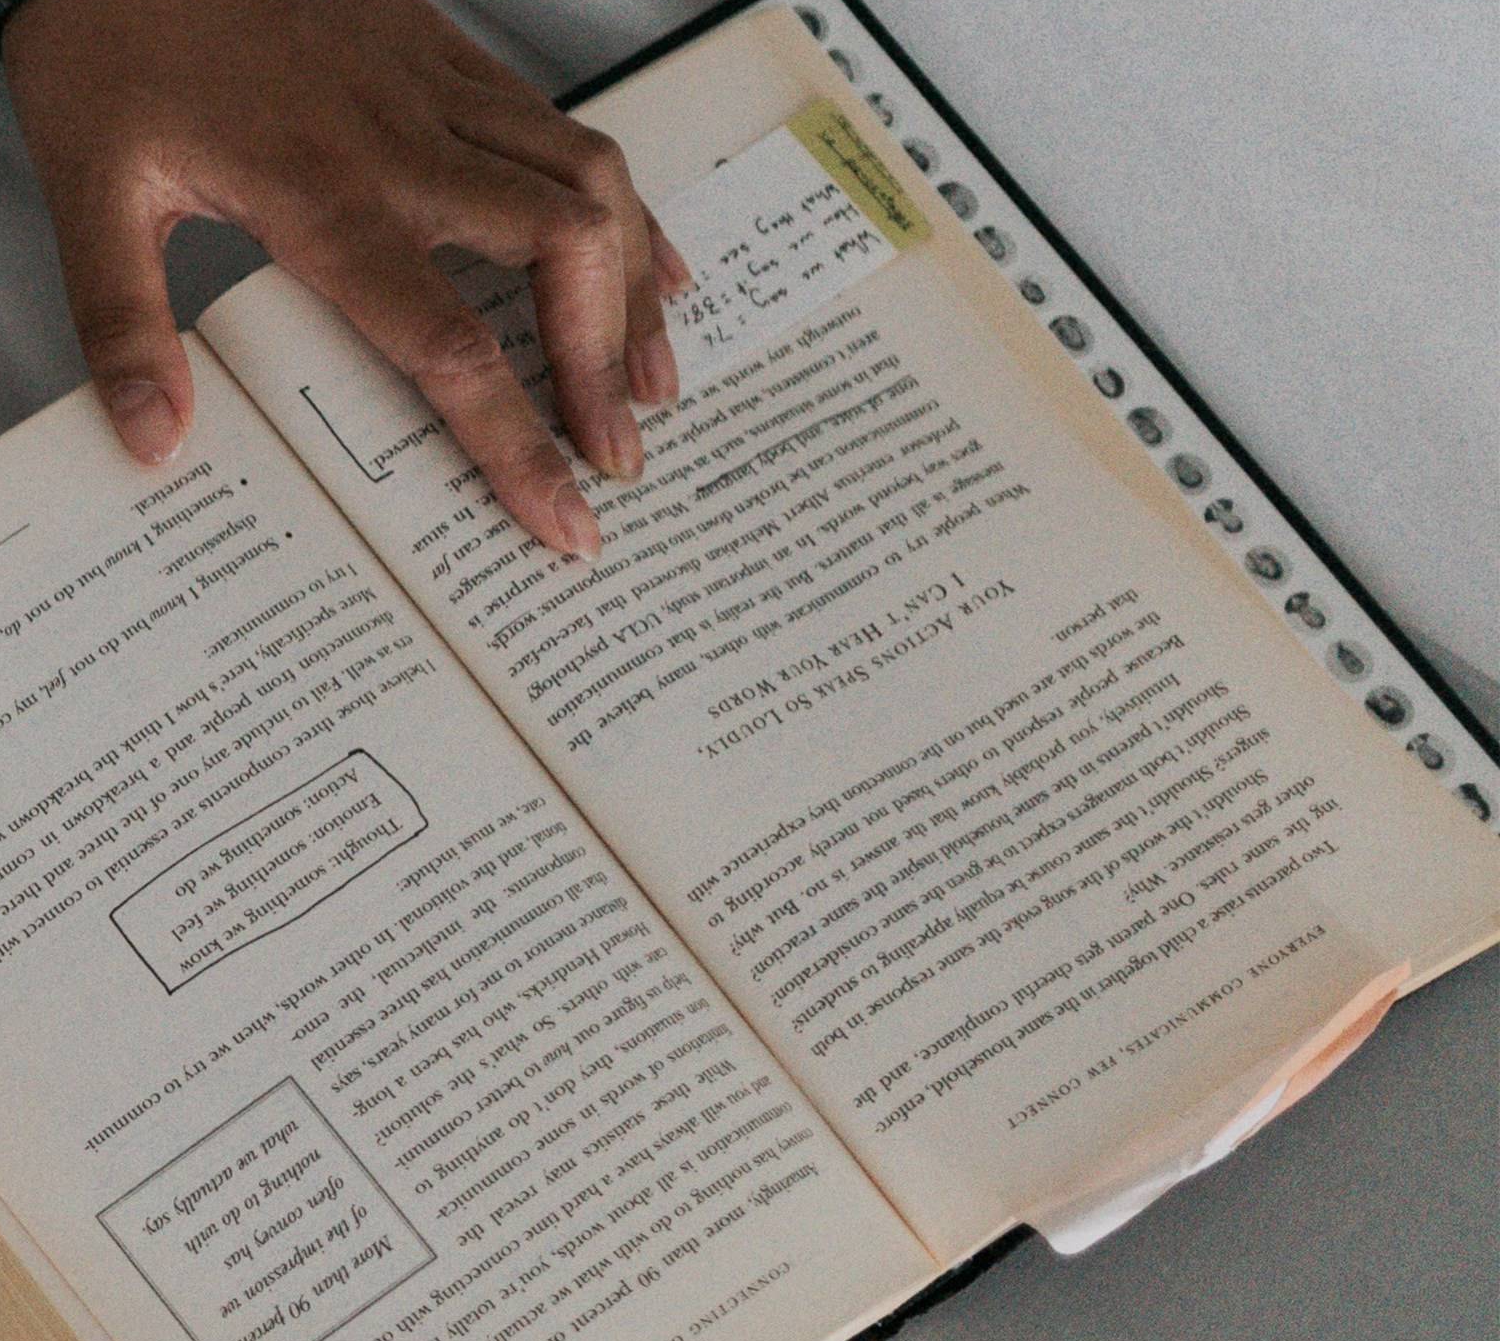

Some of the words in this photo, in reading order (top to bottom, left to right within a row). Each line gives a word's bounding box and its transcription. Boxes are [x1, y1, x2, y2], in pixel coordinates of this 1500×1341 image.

[126, 457, 216, 522] theoretical.
[152, 508, 262, 585] dispassionate.
[947, 568, 966, 591] I
[299, 765, 363, 815] Action:
[215, 801, 308, 869] something
[304, 789, 384, 849] Emotion:
[322, 811, 406, 874] Thought:
[170, 874, 202, 903] do
[194, 858, 226, 886] we
[218, 835, 315, 906] something
[198, 893, 229, 921] we
[239, 860, 334, 930] something
[167, 909, 207, 943] feel
[217, 917, 248, 945] we
[172, 934, 226, 978] know
[1240, 920, 1331, 983] EVERYONE
[1112, 972, 1249, 1061] COMMUNICATES,
[690, 1052, 737, 1091] While
[1081, 1050, 1120, 1083] FEW
[648, 1079, 696, 1119] these
[1000, 1073, 1086, 1133] CONNECT
[256, 1118, 303, 1158] what
[577, 1108, 652, 1165] statistics
[232, 1147, 262, 1175] we
[255, 1144, 327, 1202] nothing
[537, 1153, 582, 1192] may
[167, 1161, 241, 1221] actually
[240, 1191, 264, 1214] to
[300, 1171, 350, 1215] often
[484, 1181, 544, 1229] reveal
[136, 1205, 175, 1242] say.
[218, 1204, 246, 1231] do
[247, 1201, 308, 1250] convey
[321, 1216, 354, 1247] the
[343, 1199, 373, 1230] of
[180, 1220, 224, 1258] with
[346, 1232, 396, 1274] More
[451, 1219, 489, 1253] the
[220, 1242, 255, 1274] has
[236, 1232, 329, 1305] impression
[308, 1263, 354, 1302] than
[683, 1256, 796, 1339] CONNECTING
[215, 1295, 245, 1321] we
[284, 1293, 314, 1321] 90
